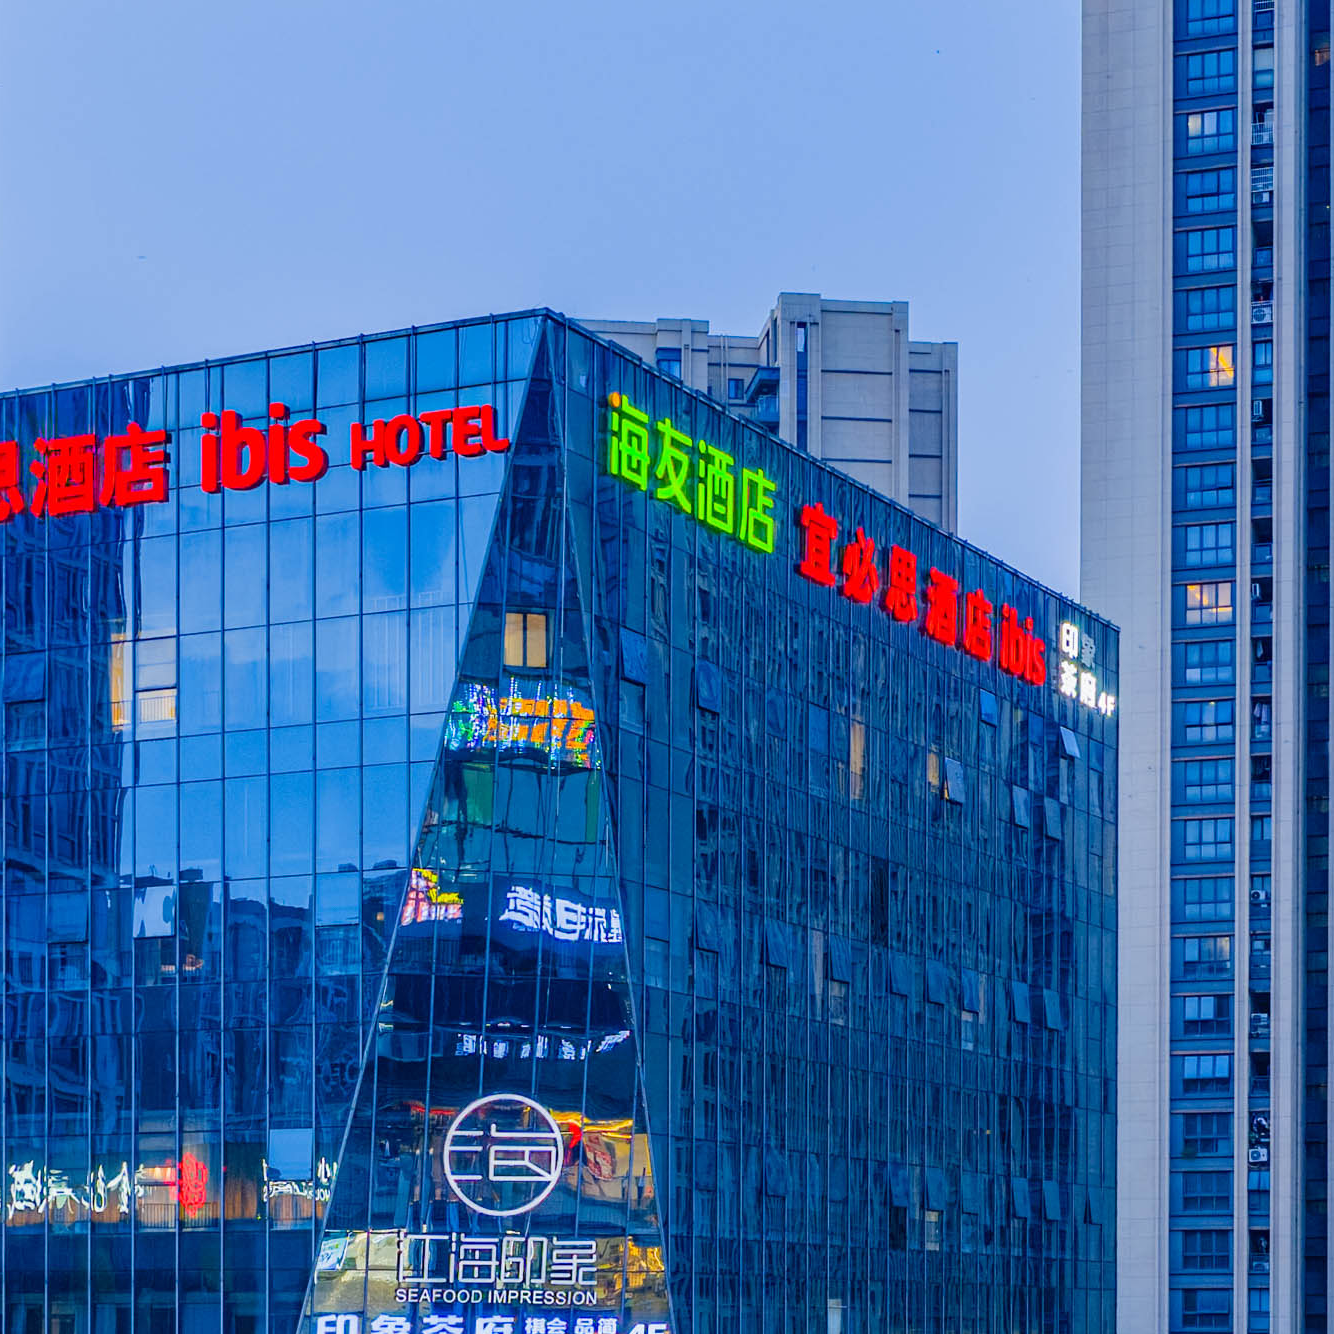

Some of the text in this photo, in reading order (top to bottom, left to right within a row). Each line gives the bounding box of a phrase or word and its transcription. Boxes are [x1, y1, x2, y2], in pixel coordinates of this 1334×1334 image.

[200, 402, 328, 494] ibis
[350, 404, 511, 471] HOTEL
[608, 393, 777, 555] 海友酒店
[800, 502, 1048, 687] 宜必思酒店 ibis
[396, 1288, 598, 1306] SEAFOOD IMPRESSION
